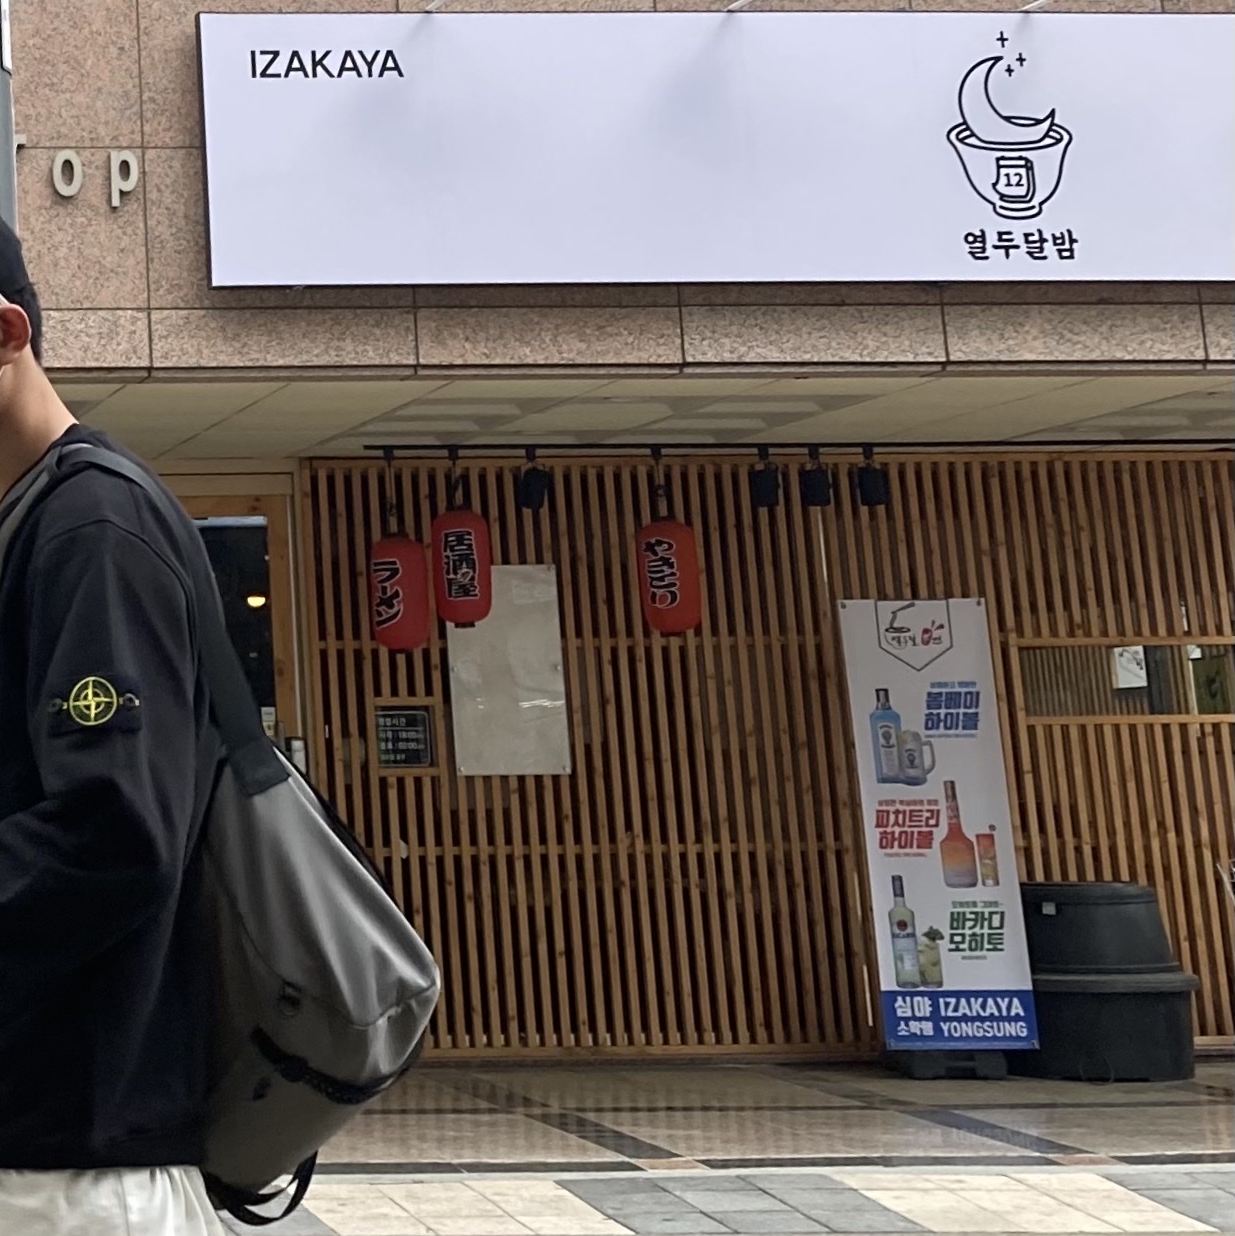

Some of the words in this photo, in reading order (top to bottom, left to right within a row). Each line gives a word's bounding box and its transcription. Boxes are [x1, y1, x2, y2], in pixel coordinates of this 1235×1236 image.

[250, 49, 405, 79] IZAKAYA
[1003, 171, 1025, 188] 12
[963, 228, 1080, 261] 열두달밤
[372, 558, 404, 630] ラーメン
[874, 808, 941, 829] 피치트리
[949, 911, 1005, 931] 바카디
[947, 931, 1005, 952] 모히토
[894, 996, 933, 1018] 심야
[938, 996, 1025, 1018] IZAKAYA
[939, 1020, 1029, 1038] YONGSUNG
